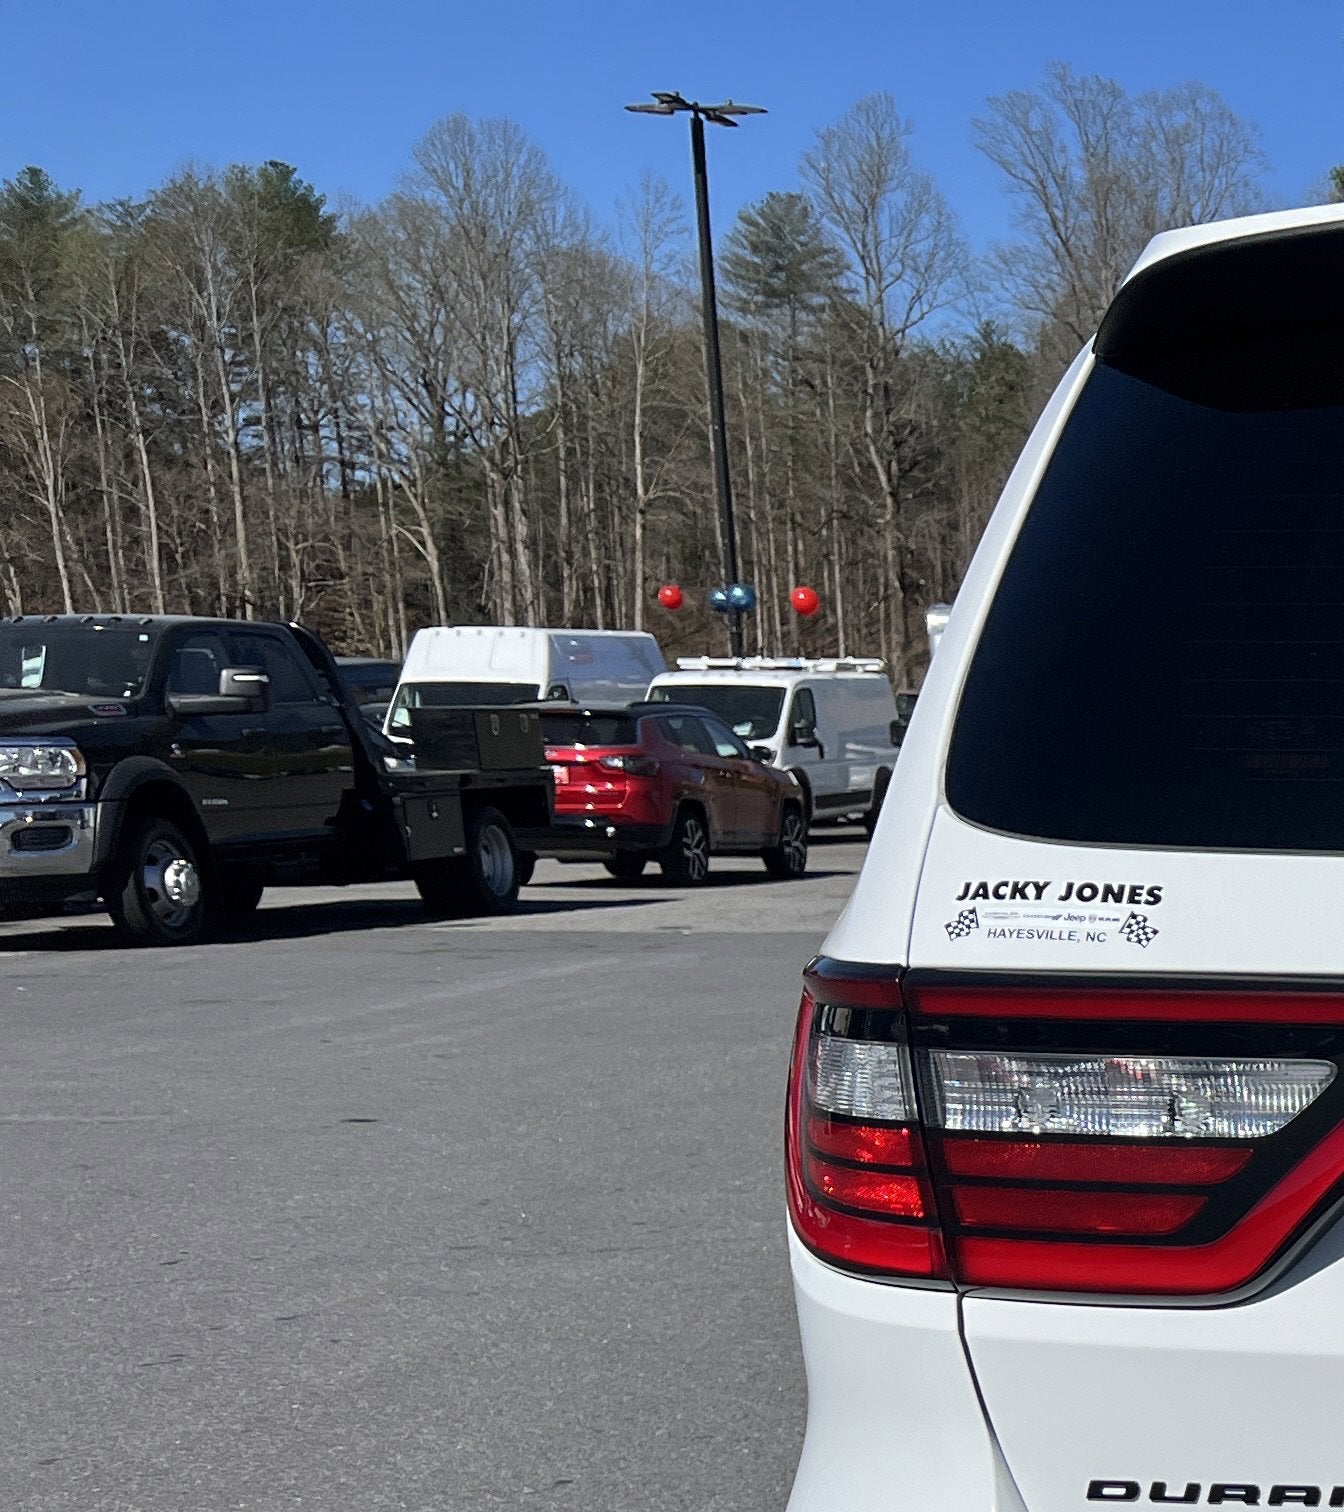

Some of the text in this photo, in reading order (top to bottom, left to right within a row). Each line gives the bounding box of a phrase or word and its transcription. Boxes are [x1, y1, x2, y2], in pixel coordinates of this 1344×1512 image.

[955, 880, 1164, 906] JACKY JONES
[986, 927, 1107, 944] HAYESVILLE, NC
